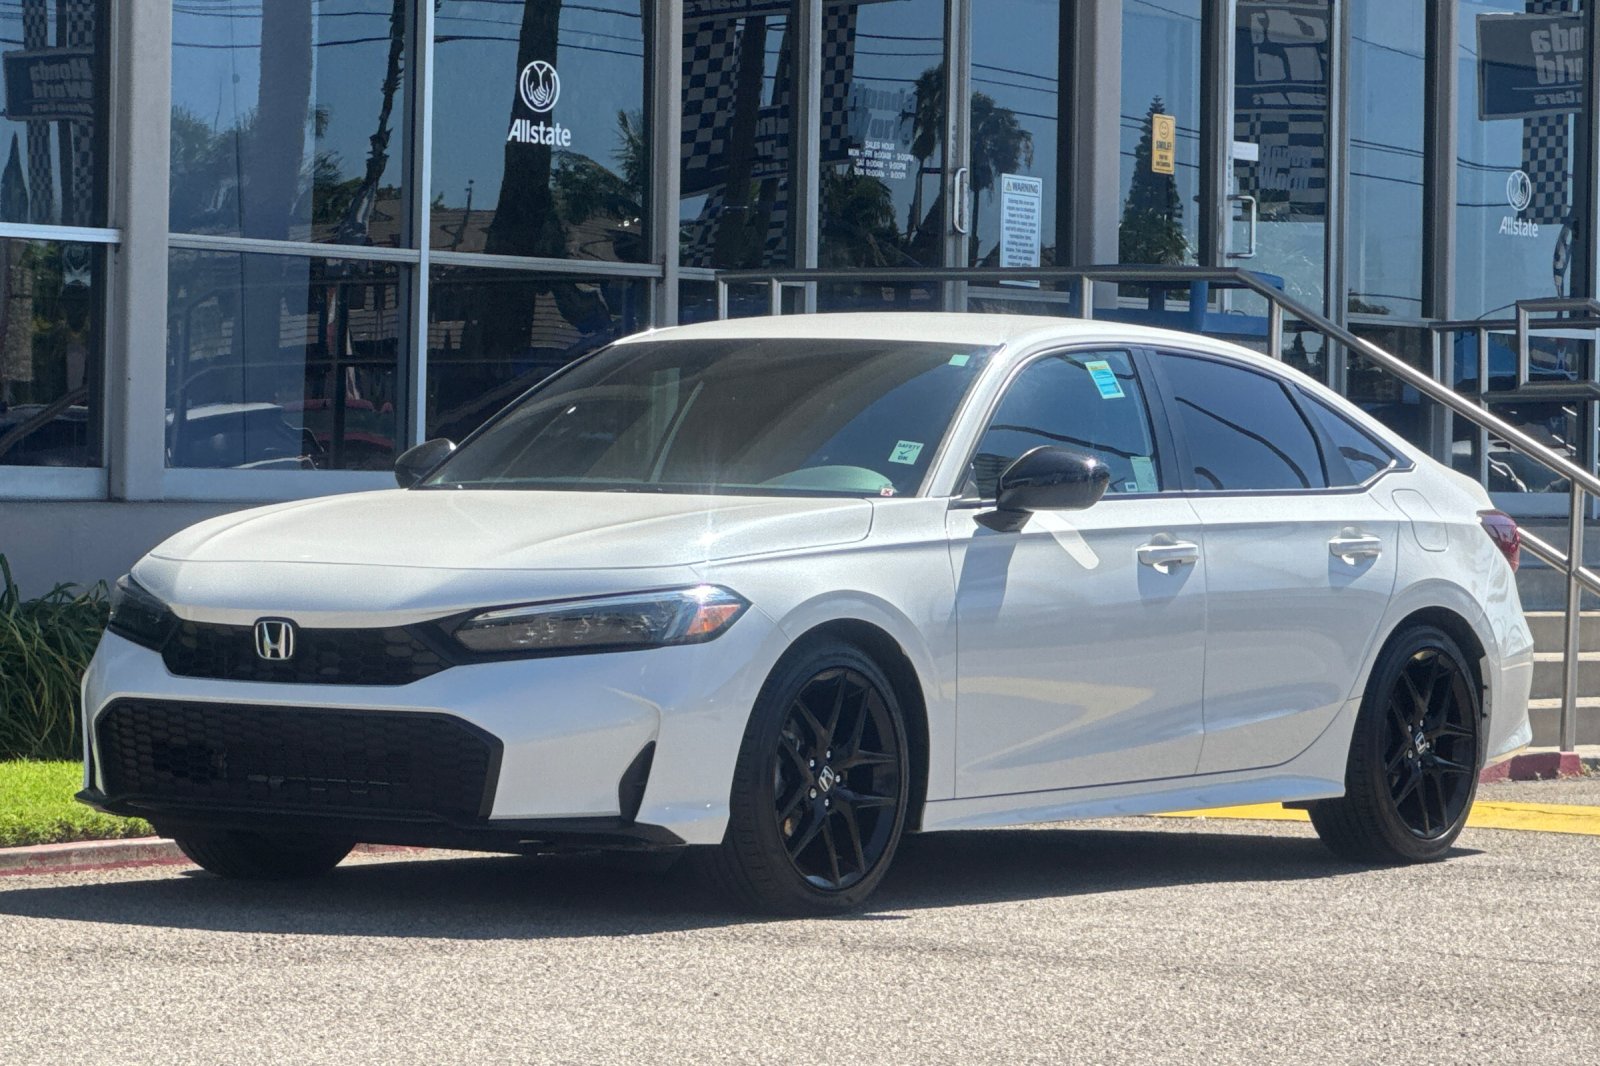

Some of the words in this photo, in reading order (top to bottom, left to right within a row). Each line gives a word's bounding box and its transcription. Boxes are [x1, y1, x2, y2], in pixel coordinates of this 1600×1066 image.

[506, 118, 571, 147] Allstate
[1012, 181, 1039, 194] WARNING
[1498, 215, 1539, 238] Allstate
